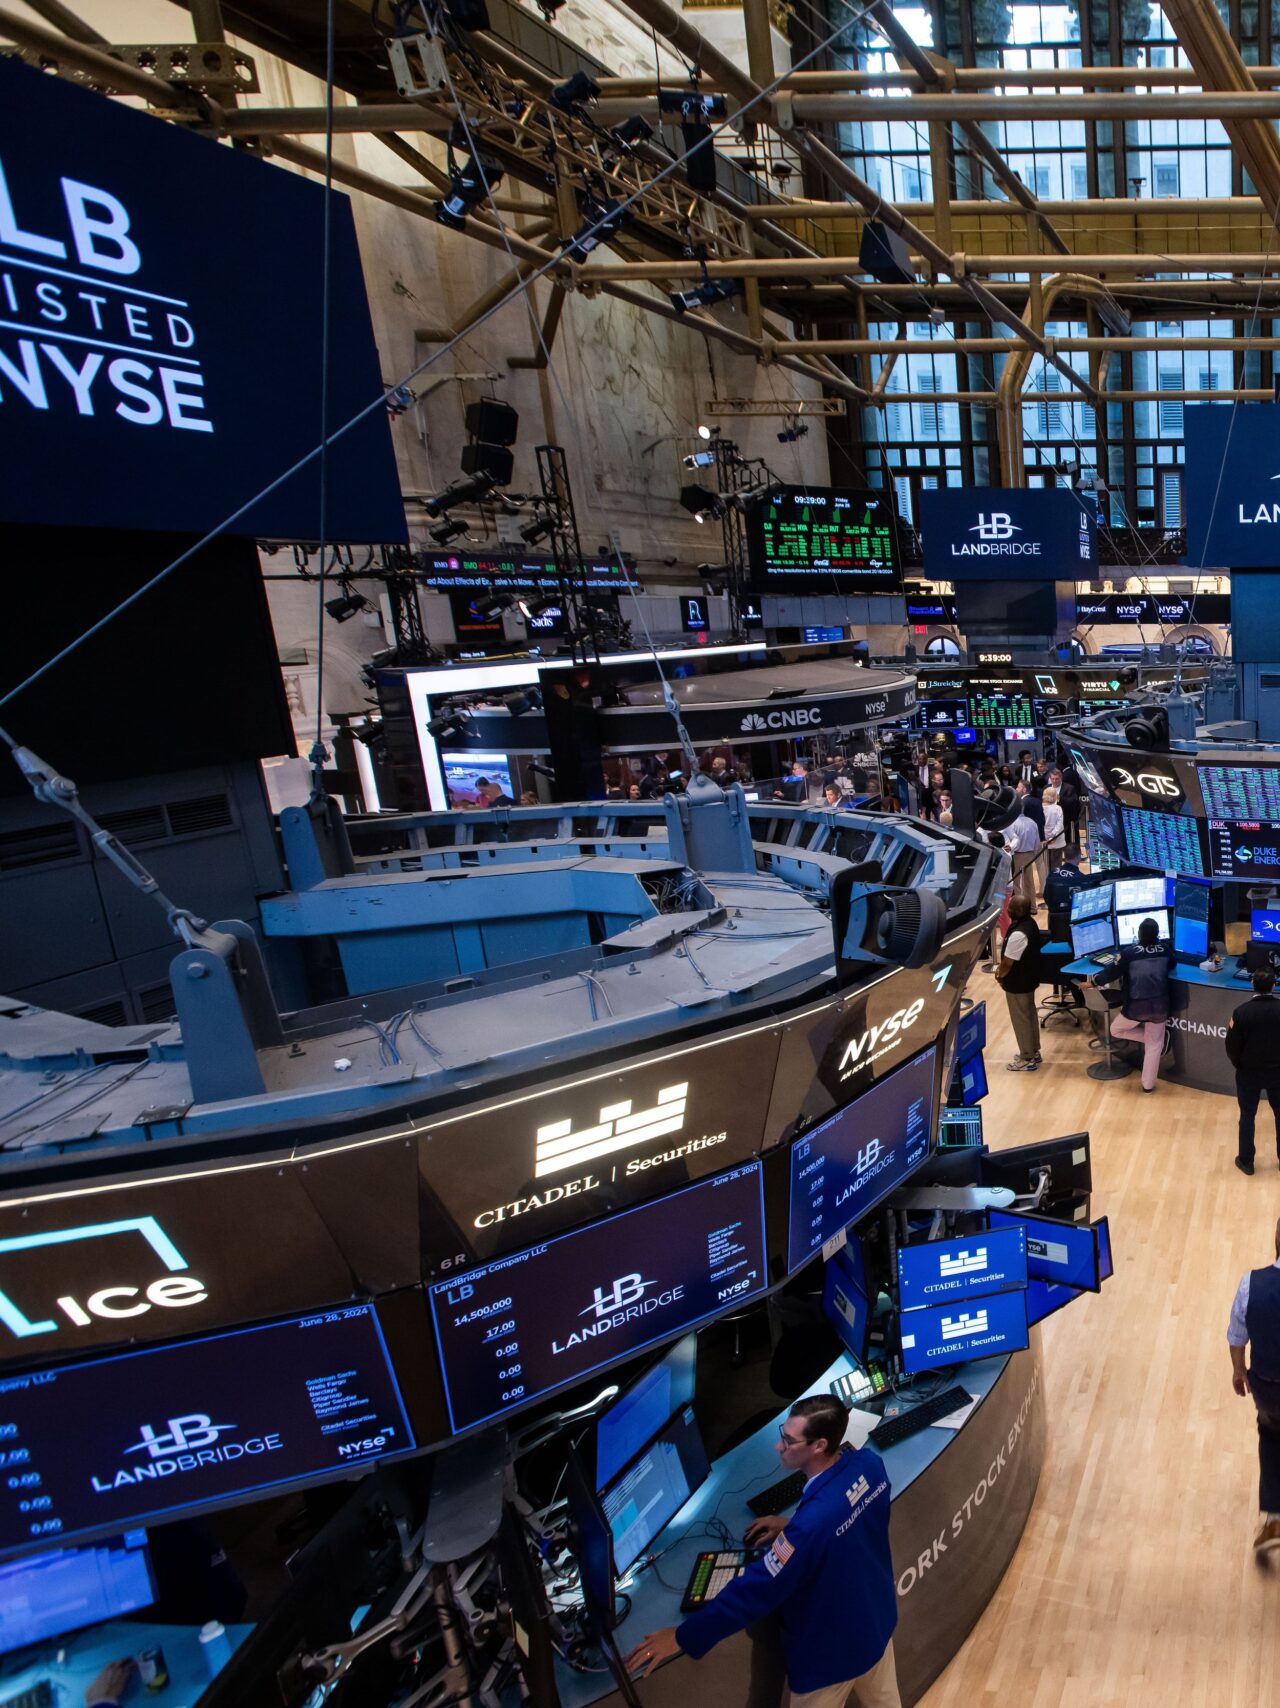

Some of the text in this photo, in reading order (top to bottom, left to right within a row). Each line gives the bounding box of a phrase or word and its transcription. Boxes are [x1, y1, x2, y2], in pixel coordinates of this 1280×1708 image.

[0, 159, 141, 275] LB
[2, 273, 194, 349] ISTED
[0, 338, 214, 433] NYSE
[978, 512, 1012, 539] LB
[952, 542, 1041, 556] LANDBRIDGE
[979, 654, 1011, 662] 9:39:00
[768, 708, 822, 729] CNBC
[865, 701, 886, 715] NYSE
[1137, 774, 1180, 797] GTS
[1253, 847, 1277, 856] DUKE
[838, 997, 925, 1071] NYSE
[1166, 1017, 1227, 1039] EXCHANG
[798, 1144, 810, 1161] LB
[856, 1138, 880, 1175] LB
[473, 1129, 727, 1230] CITADEL Securities
[835, 1150, 895, 1207] LANDBRIDGE
[434, 1245, 547, 1294] LandBridge Company LLC
[440, 1253, 467, 1270] 6 R
[447, 1283, 474, 1305] LB
[594, 1272, 645, 1318] LB
[718, 1279, 750, 1300] NYSE
[924, 1273, 1005, 1294] CITADEL Securities
[298, 1317, 323, 1328] June
[342, 1307, 368, 1319] 2024
[454, 1297, 513, 1327] 14,500,000
[552, 1285, 684, 1354] LANDBRIDGE
[486, 1320, 515, 1339] 17.00
[496, 1342, 518, 1357] 0.00
[926, 1334, 1006, 1358] CITADEL Securities
[499, 1364, 521, 1379] 0.00
[502, 1385, 524, 1400] 0.00
[140, 1413, 219, 1458] LB
[338, 1435, 386, 1456] NYSE
[90, 1433, 283, 1492] LANDBRIDGE
[836, 1505, 863, 1536] CITADEL
[897, 1526, 948, 1597] ORK
[952, 1449, 1007, 1538] STOCK
